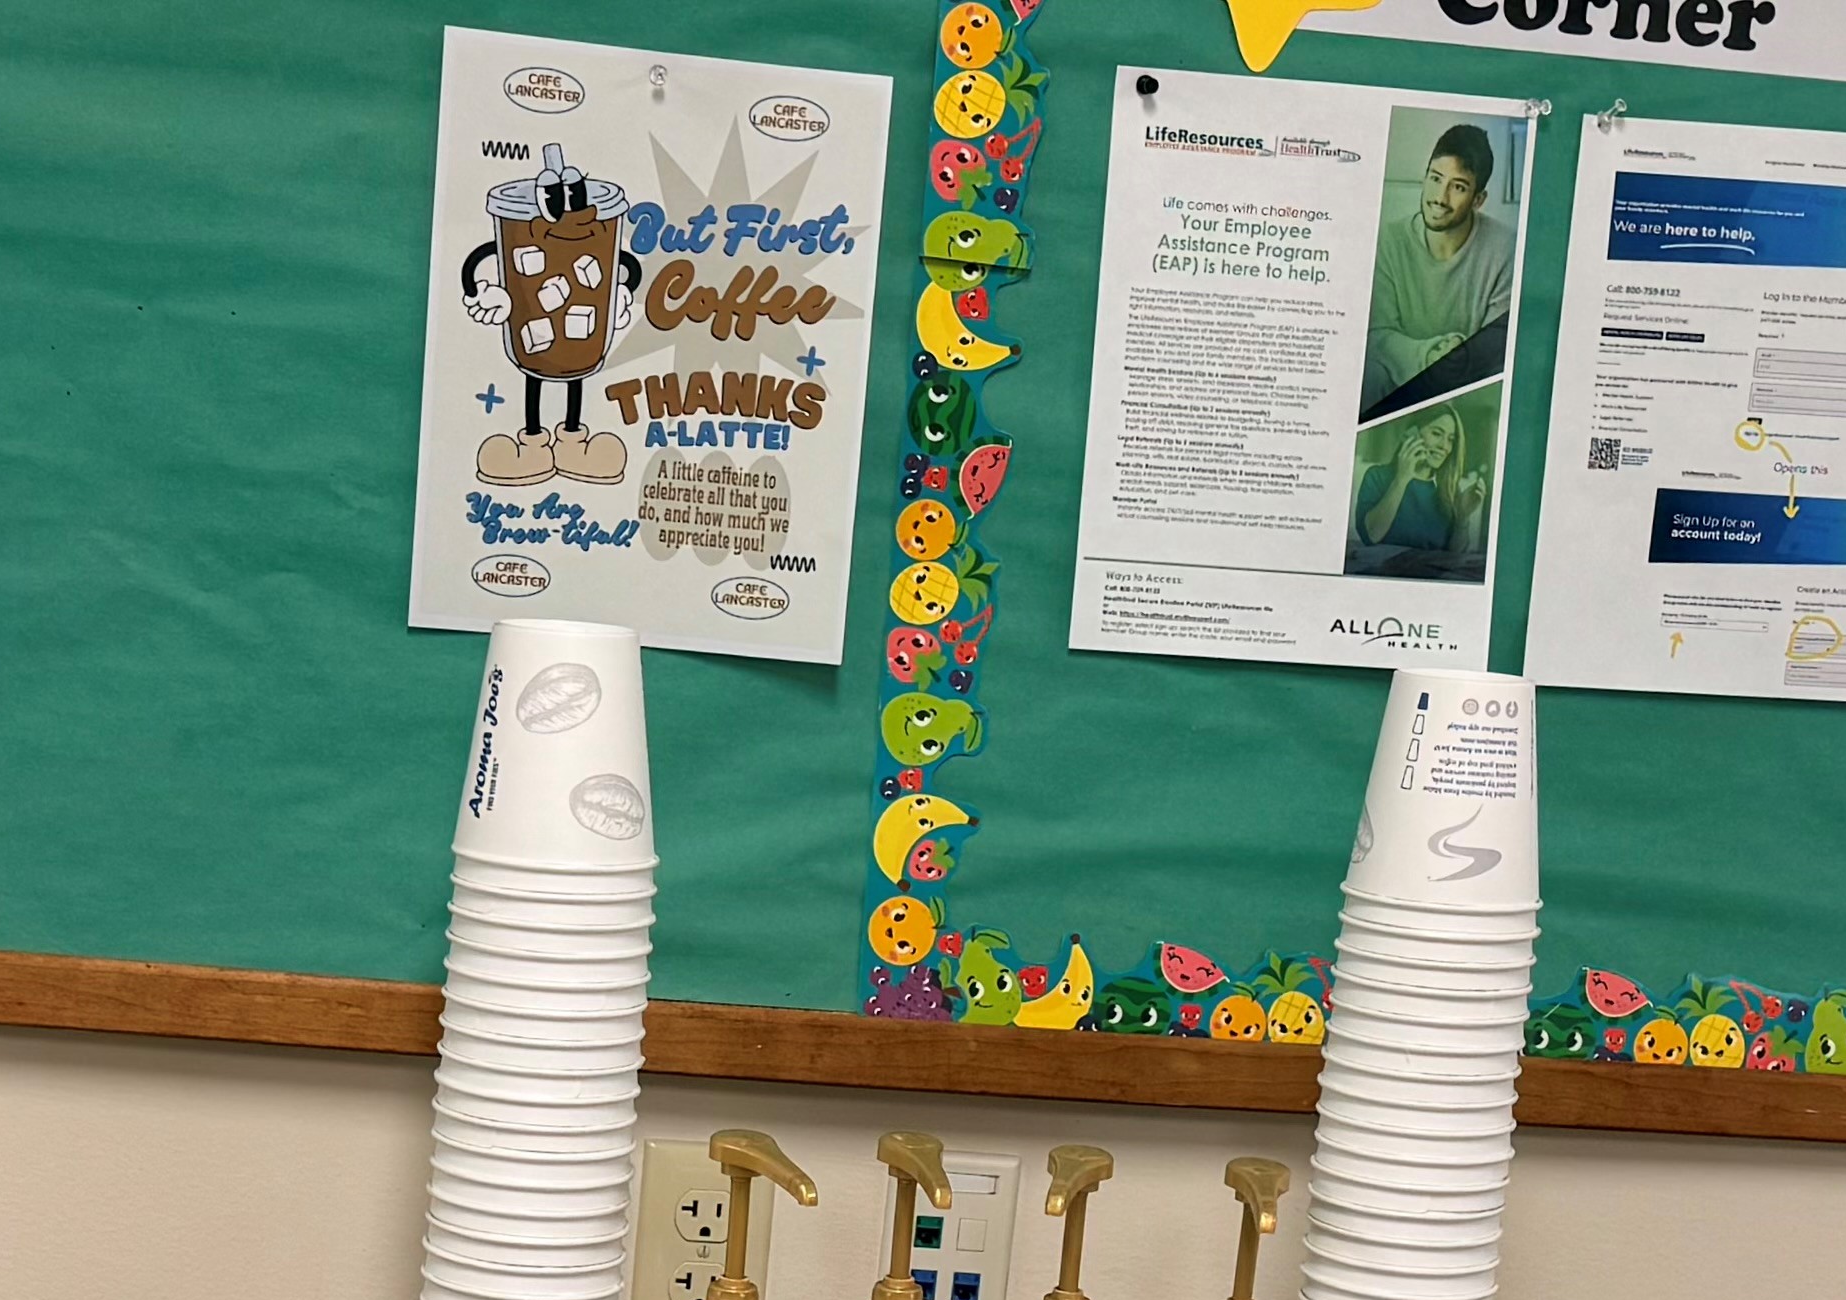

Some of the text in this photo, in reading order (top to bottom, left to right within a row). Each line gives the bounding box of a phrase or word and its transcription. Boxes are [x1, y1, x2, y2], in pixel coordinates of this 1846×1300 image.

[508, 83, 581, 103] LANCASTER
[528, 73, 562, 88] CAFE
[772, 103, 808, 118] CAFE
[752, 114, 826, 133] LANCASTER
[1144, 126, 1264, 150] LifeResources
[1163, 197, 1333, 222] Life comes with challenges.
[627, 201, 855, 257] But First,
[1181, 214, 1312, 241] Your Employee
[1613, 219, 1756, 243] We are here to help.
[1157, 234, 1330, 262] Assistance Program
[1152, 253, 1331, 285] (EAP) is here to help.
[644, 258, 837, 341] Coffee
[604, 371, 827, 430] THANKS
[644, 420, 792, 451] A-LATTE!
[657, 460, 777, 489] A little caffeine to
[1773, 462, 1829, 475] Opens this
[466, 491, 586, 523] You Are
[643, 481, 788, 516] celebrate all that you
[638, 501, 790, 533] do, and how much we
[1673, 513, 1756, 529] Sign Up for an
[481, 516, 640, 552] Brew-tiful!
[658, 529, 765, 555] appreciate you!
[1671, 528, 1762, 545] account today!
[475, 571, 547, 589] LANCASTER
[495, 561, 529, 575] CAFE
[715, 592, 786, 609] LANCASTER
[735, 583, 769, 596] CAFE
[468, 731, 493, 819] Aroma
